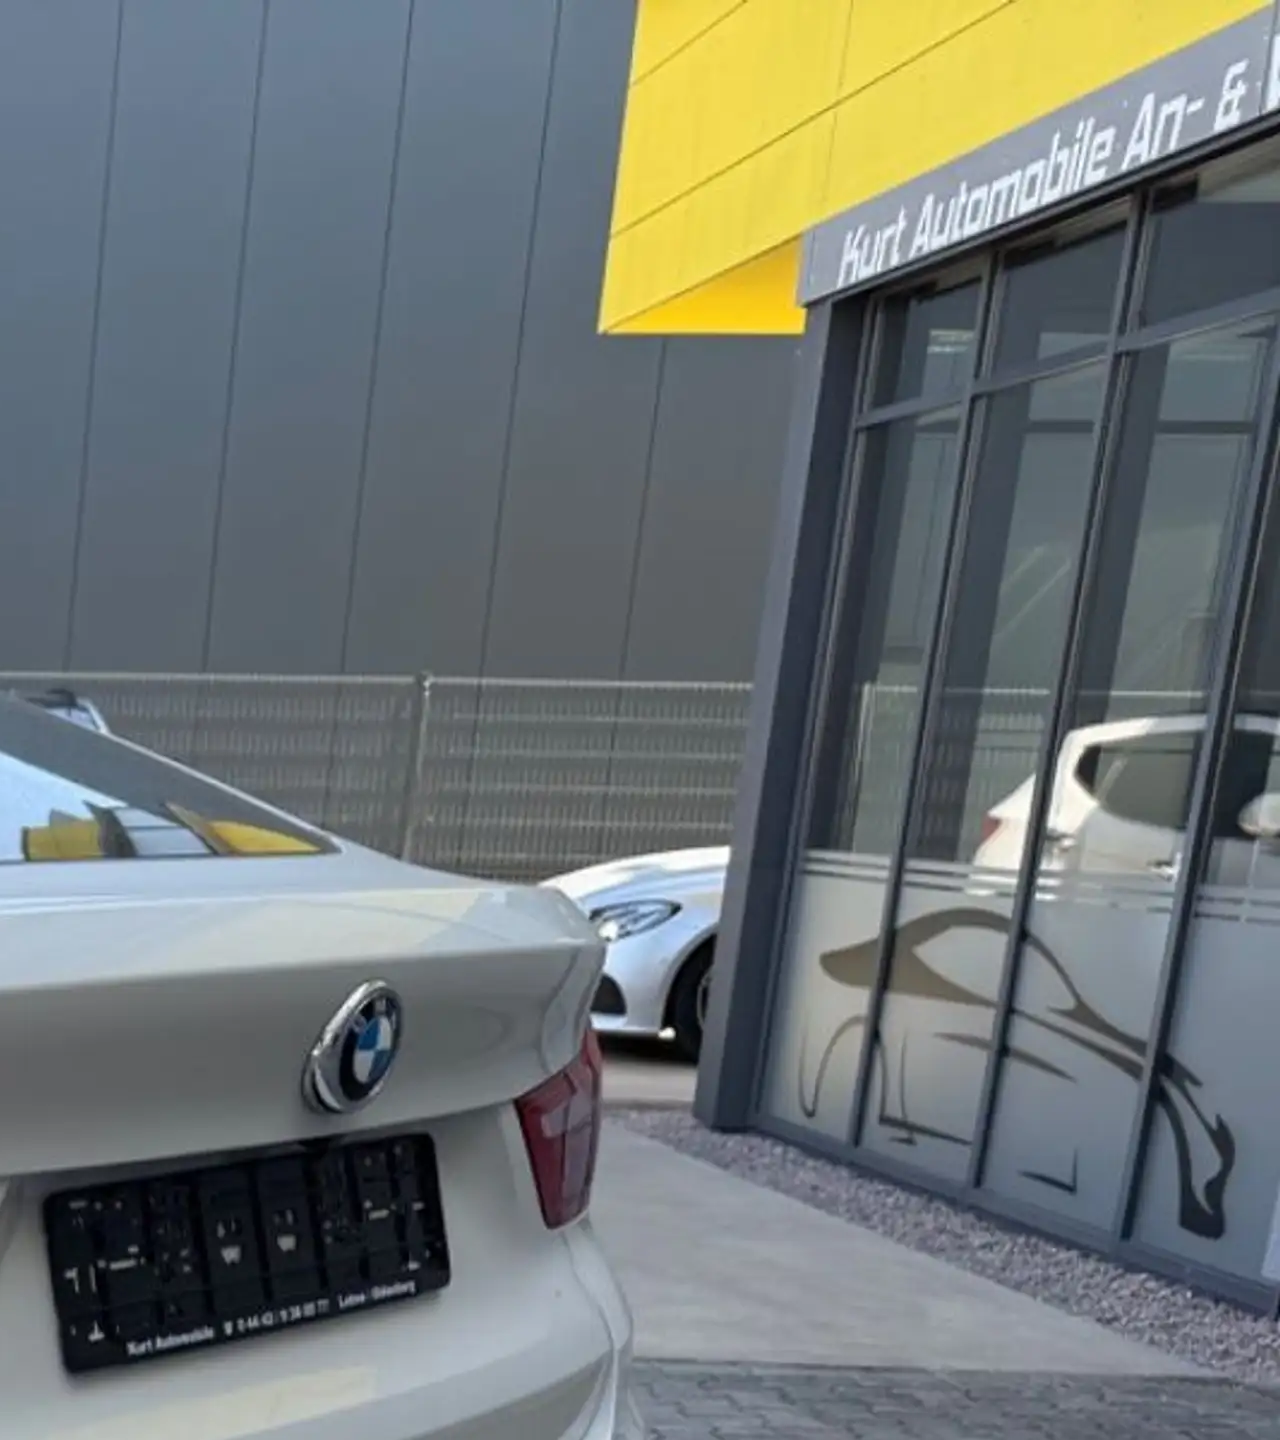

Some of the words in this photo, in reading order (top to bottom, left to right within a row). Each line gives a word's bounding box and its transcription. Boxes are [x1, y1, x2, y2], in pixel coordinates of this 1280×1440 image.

[837, 206, 907, 287] Kurt
[910, 116, 1117, 254] Automobile
[1120, 92, 1207, 171] An-
[1213, 58, 1249, 131] &
